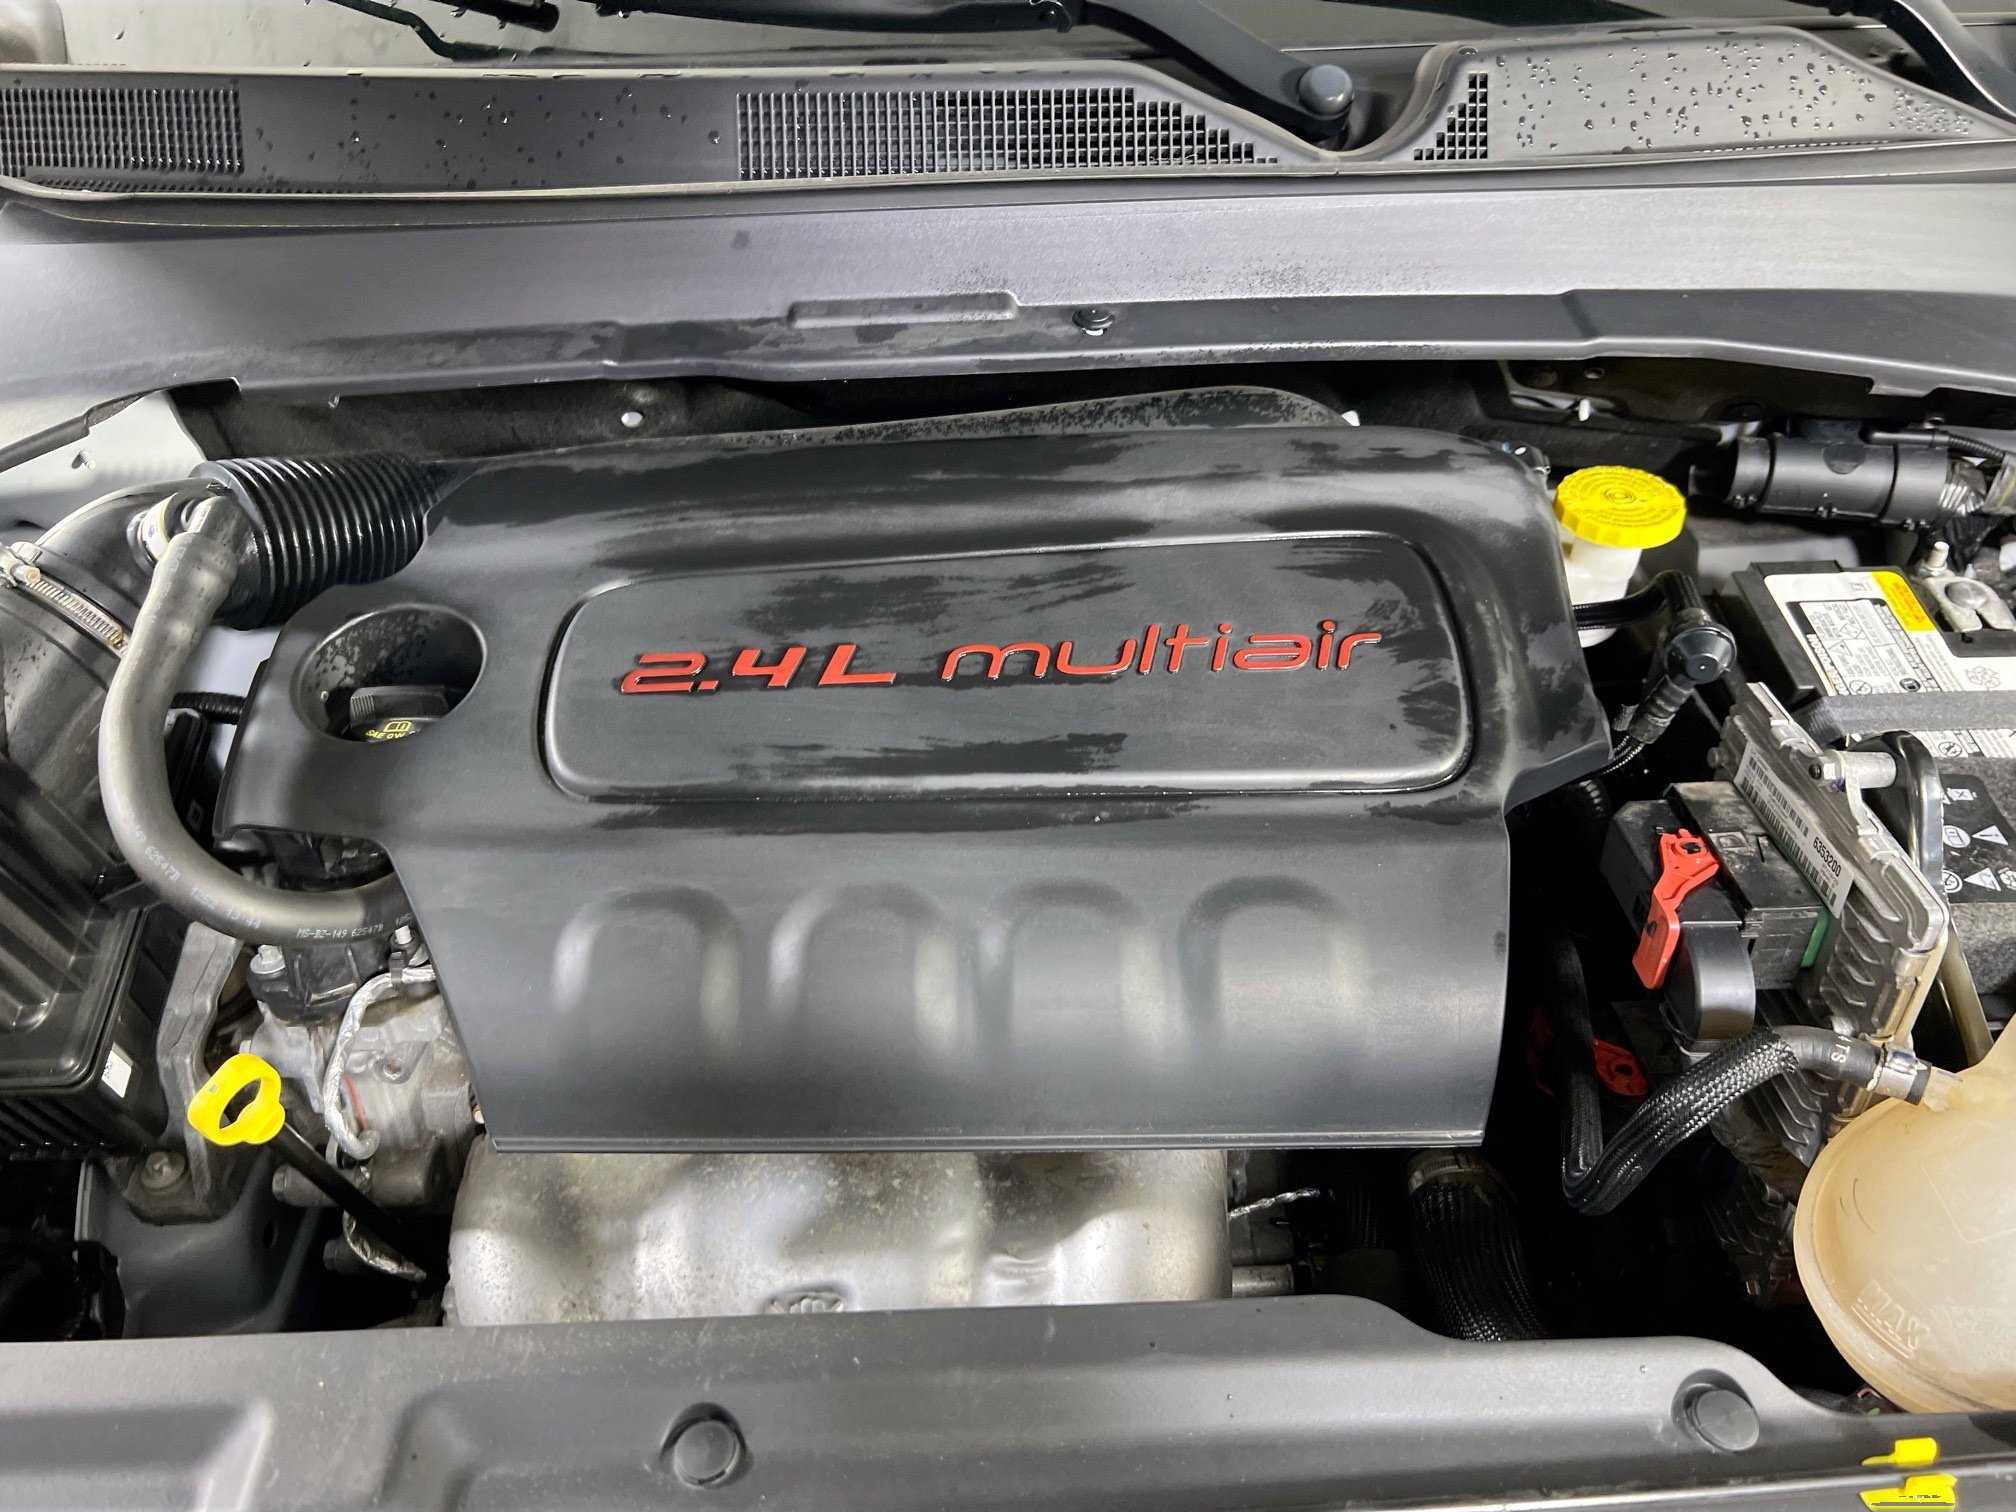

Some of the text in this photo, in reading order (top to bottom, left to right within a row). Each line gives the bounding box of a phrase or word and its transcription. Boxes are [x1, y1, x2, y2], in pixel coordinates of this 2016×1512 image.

[941, 620, 1382, 681] multiair
[366, 730, 386, 738] SAE
[1813, 837, 1842, 877] 6353200
[1857, 1278, 1931, 1351] MAX
